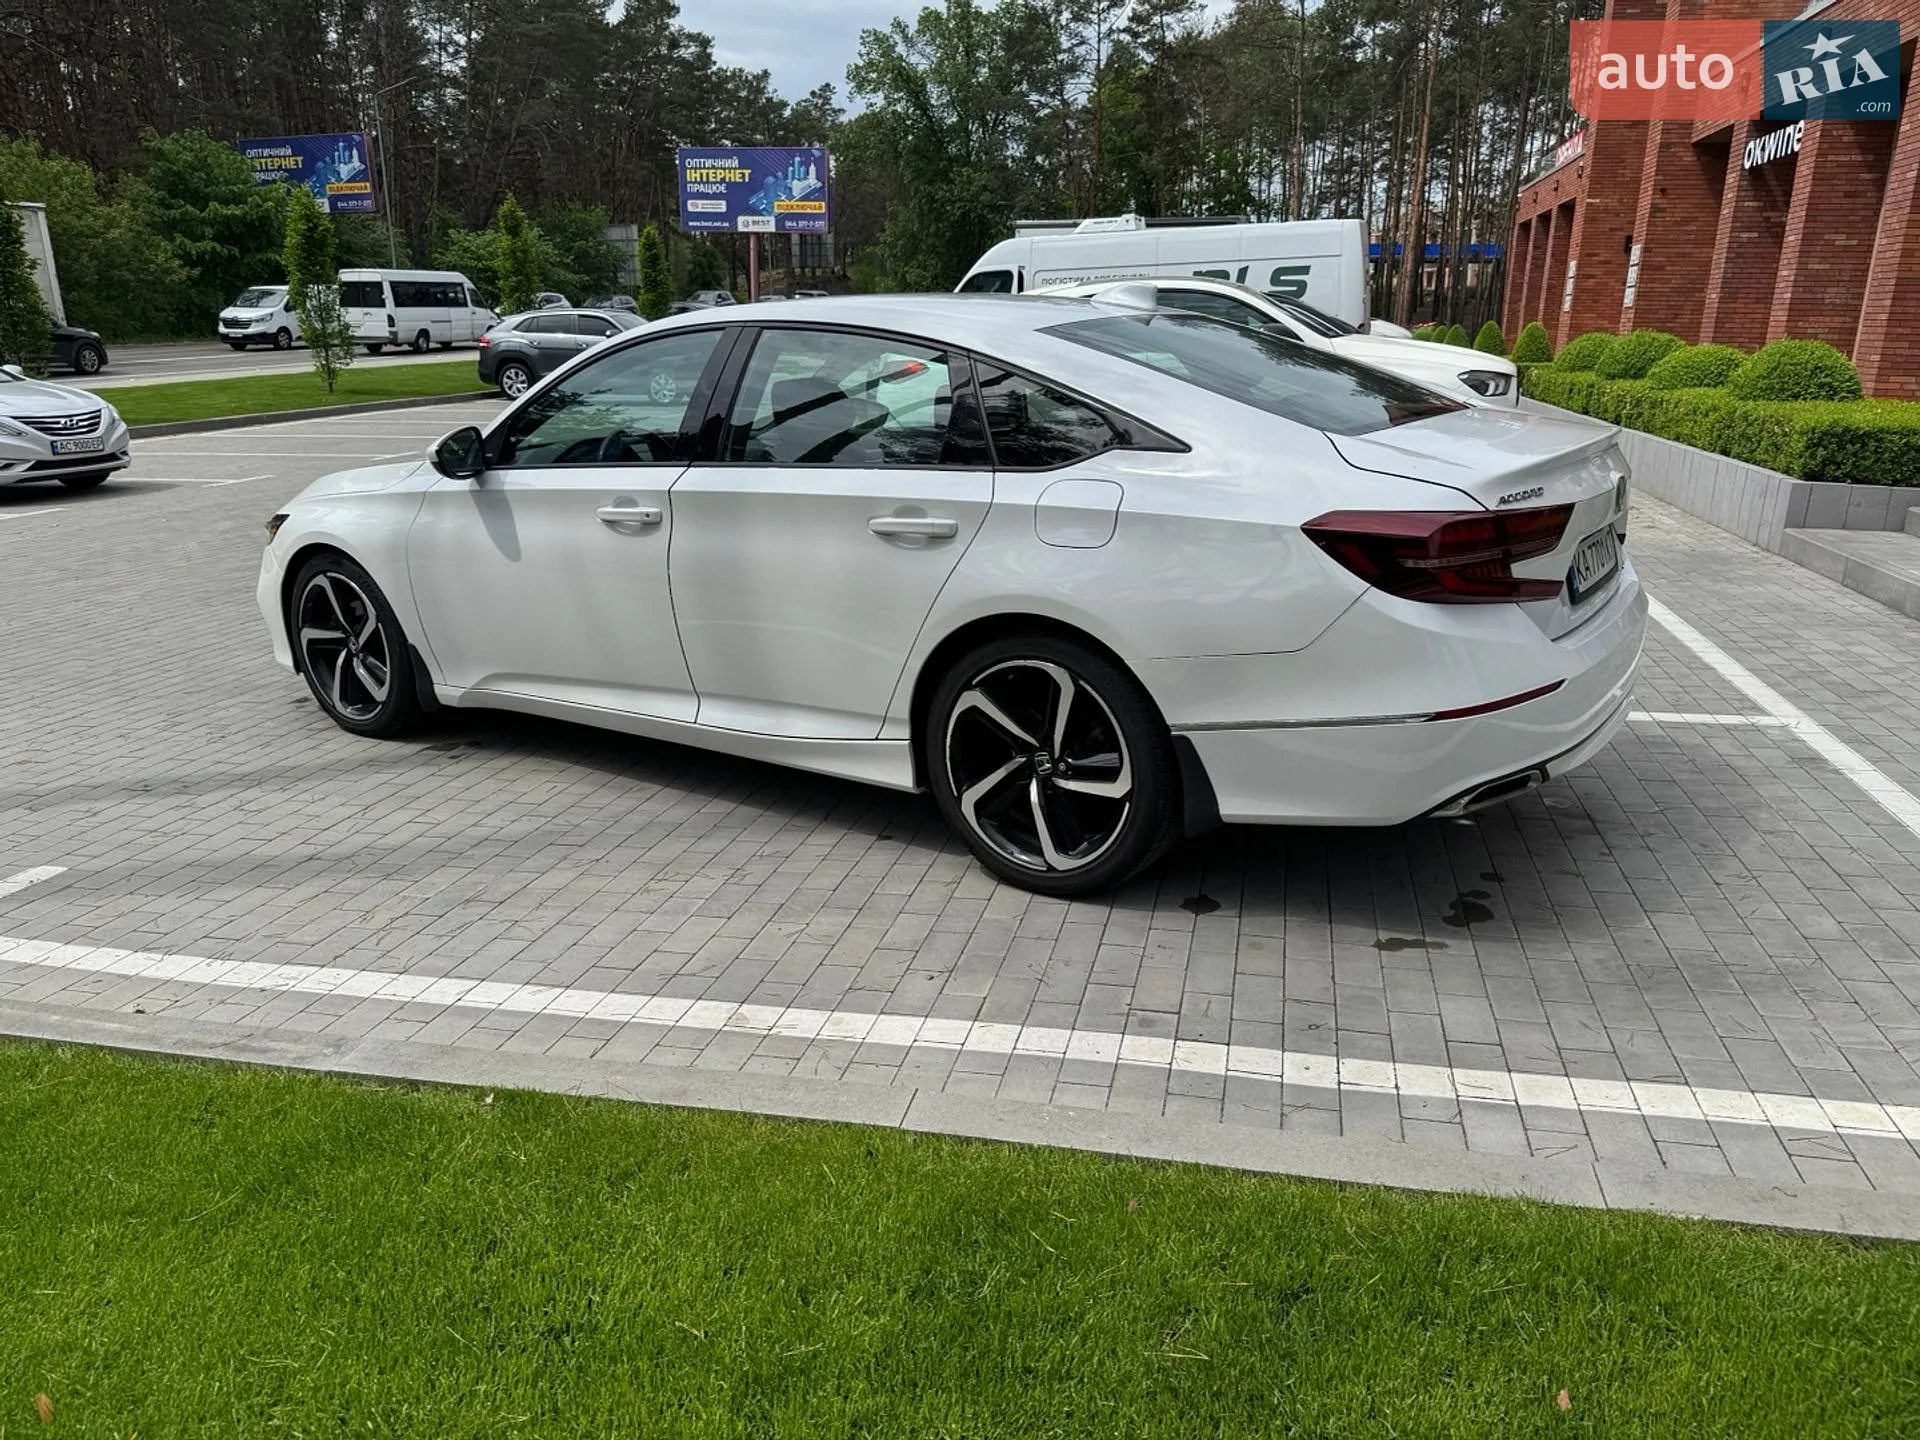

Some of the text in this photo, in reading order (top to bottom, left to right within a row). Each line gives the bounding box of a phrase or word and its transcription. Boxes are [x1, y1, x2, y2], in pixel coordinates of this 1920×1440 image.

[246, 146, 293, 158] ОПТИЧНИЙ
[685, 156, 739, 168] ОПТИЧНИЙ
[686, 169, 751, 182] ІНТЕРНЕТ
[687, 183, 727, 194] ПРАЦЮЄ
[1496, 487, 1544, 507] ACCORD
